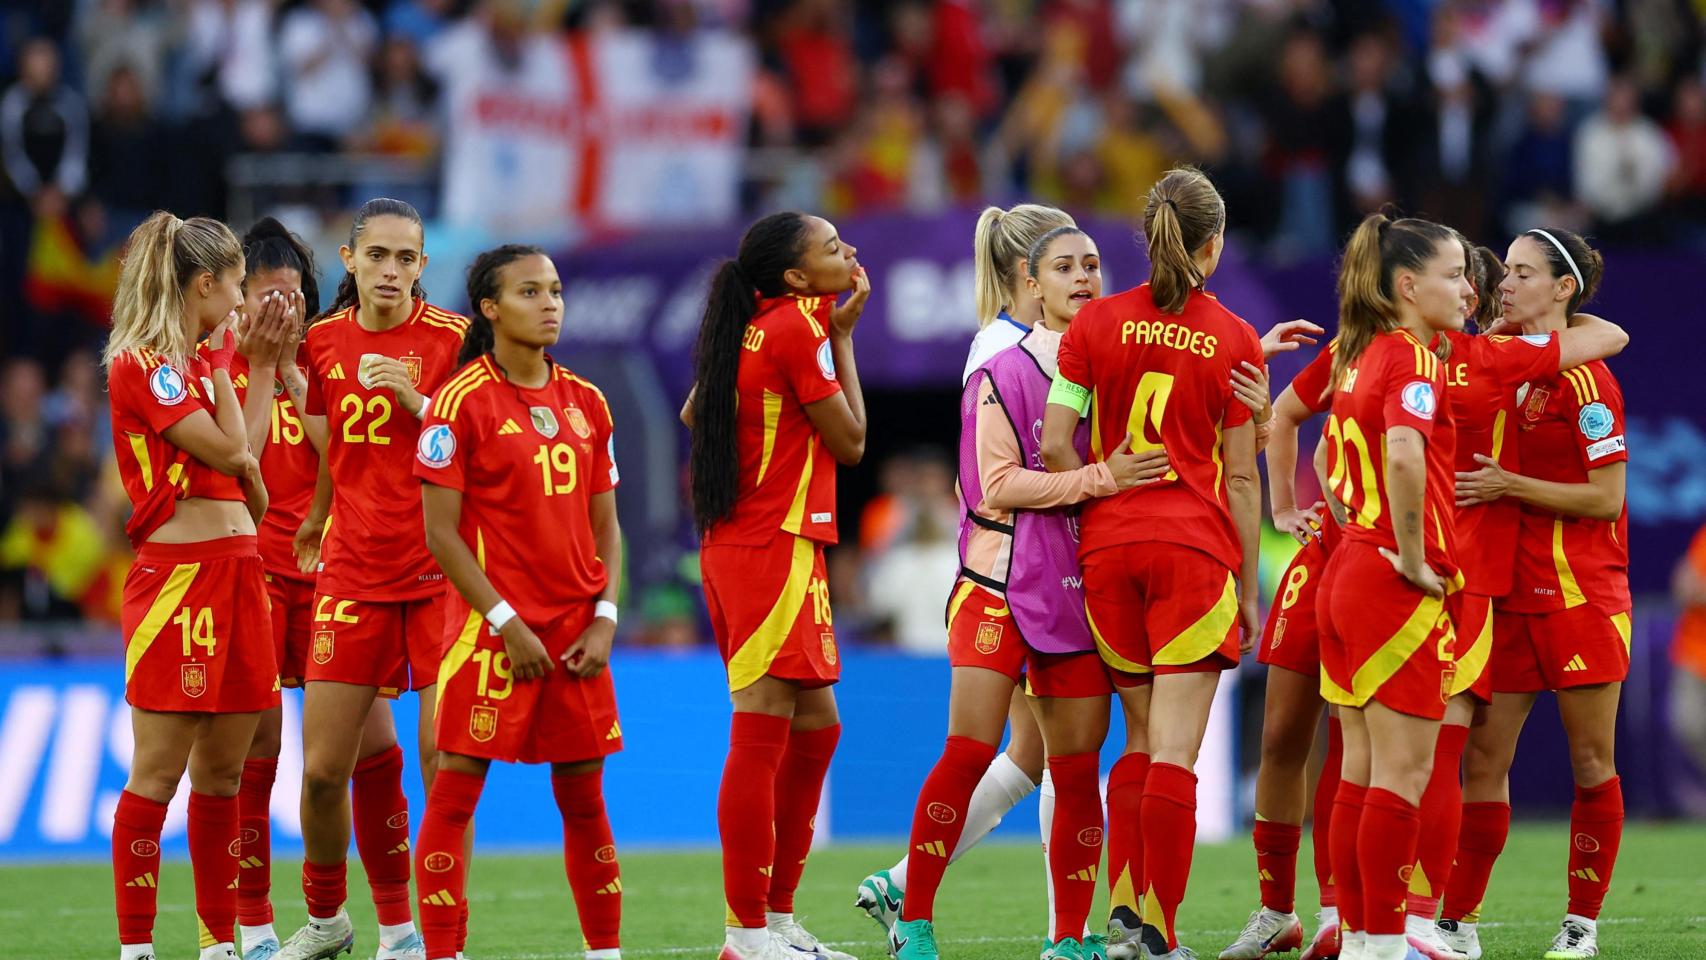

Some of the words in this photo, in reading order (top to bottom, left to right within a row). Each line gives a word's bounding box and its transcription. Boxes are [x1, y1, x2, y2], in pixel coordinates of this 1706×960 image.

[1122, 320, 1218, 358] PAREDES
[271, 399, 304, 445] 15
[341, 393, 391, 445] 22
[1127, 371, 1178, 481] 4
[534, 443, 576, 496] 19
[808, 577, 832, 626] 18
[1281, 565, 1309, 610] 8
[173, 607, 217, 656] 14
[472, 649, 514, 700] 19
